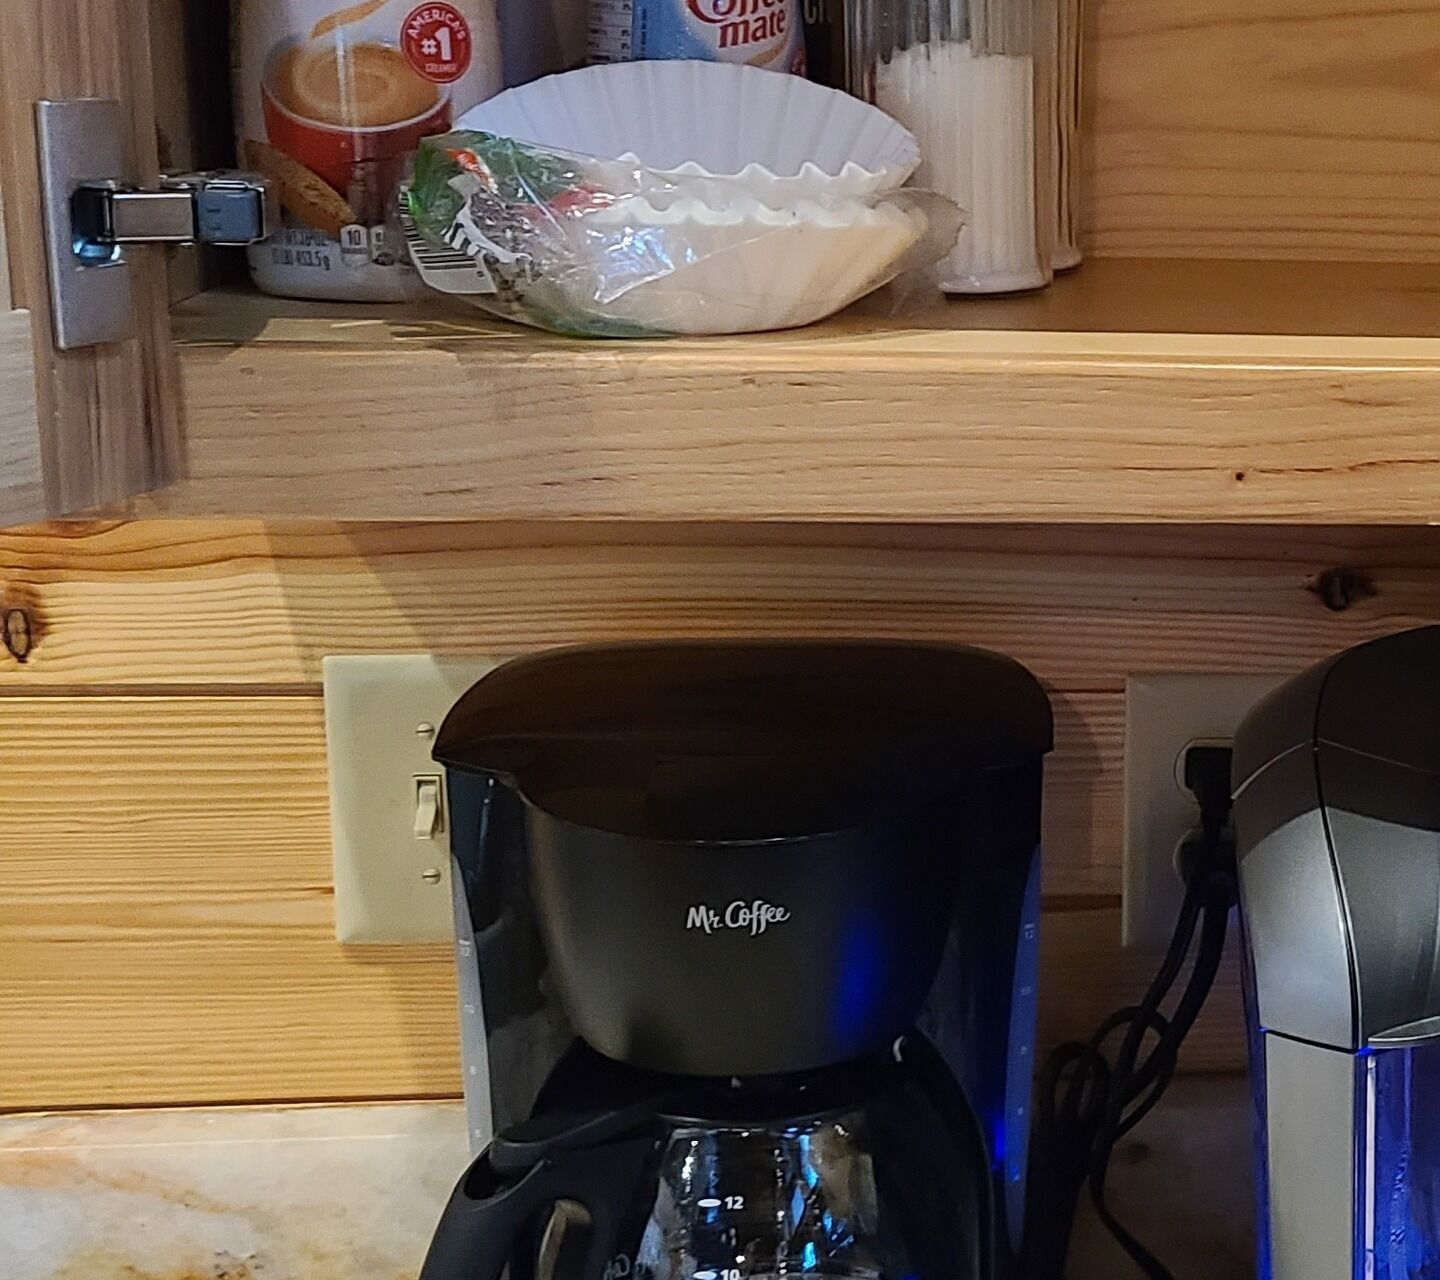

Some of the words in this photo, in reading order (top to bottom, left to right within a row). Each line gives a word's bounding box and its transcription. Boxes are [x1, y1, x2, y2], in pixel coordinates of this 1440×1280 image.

[420, 26, 452, 61] #1
[718, 9, 786, 49] mate
[724, 900, 791, 937] Coffee
[723, 1195, 745, 1210] 12
